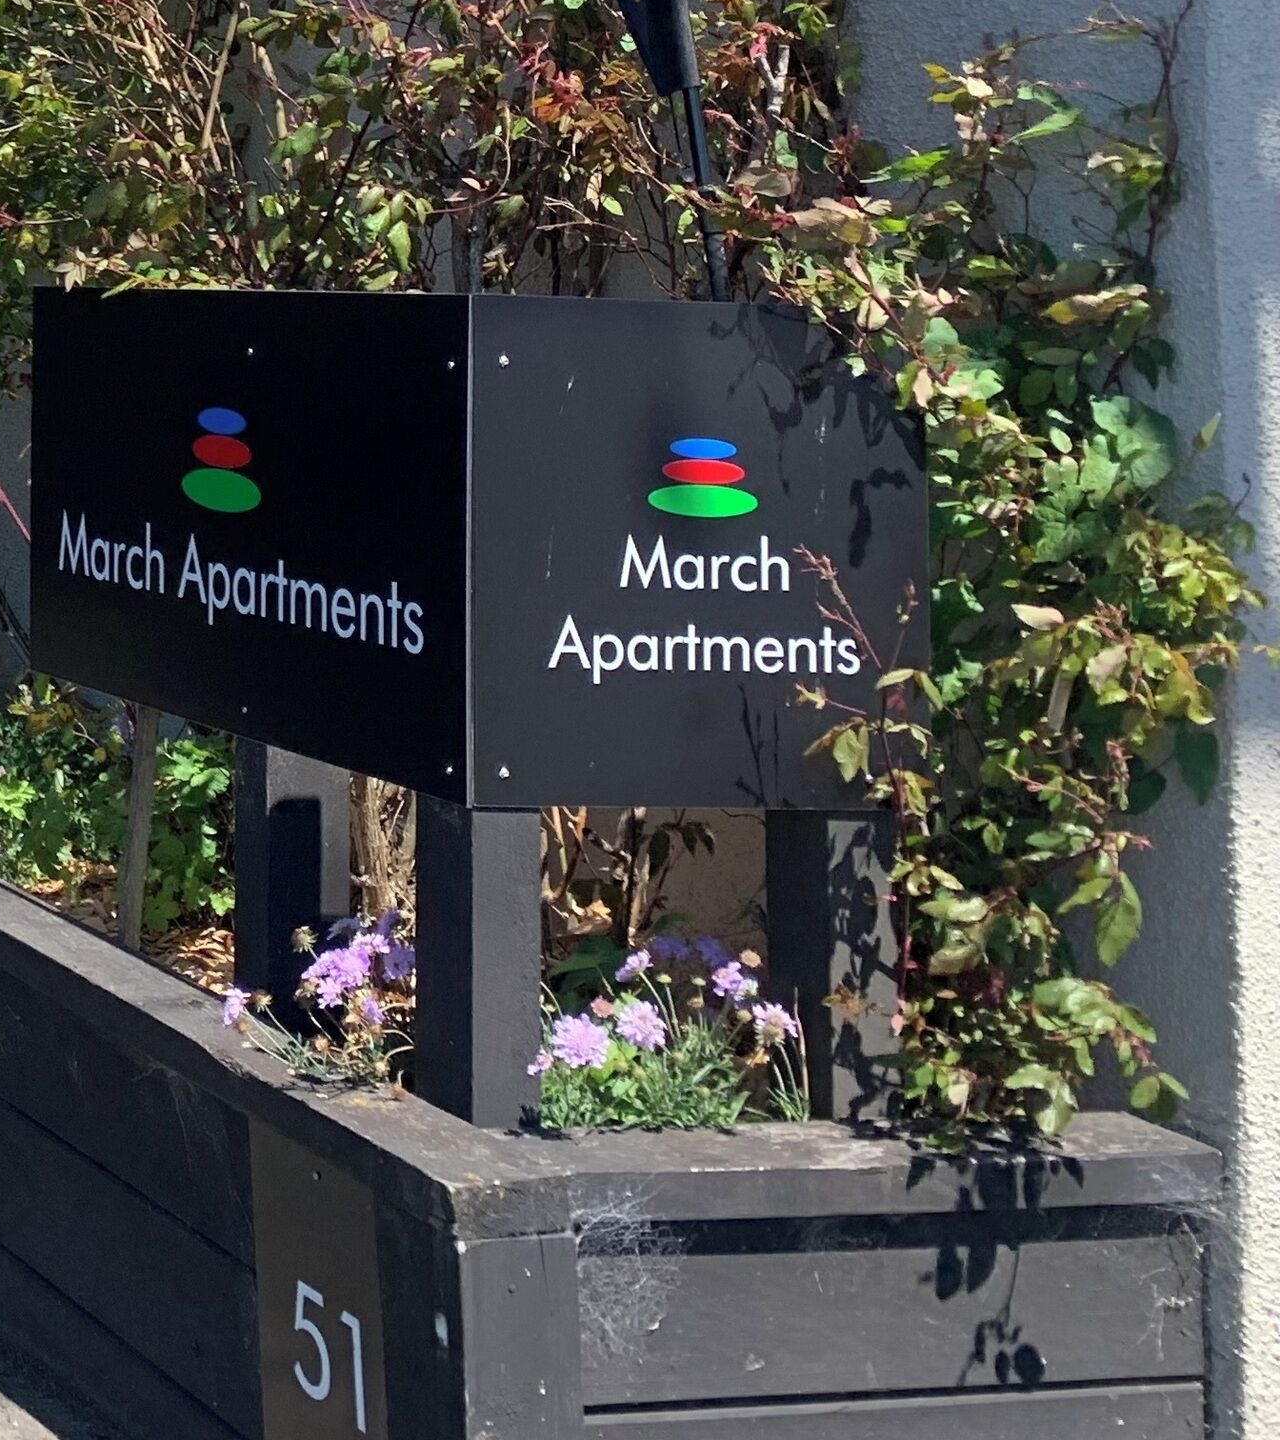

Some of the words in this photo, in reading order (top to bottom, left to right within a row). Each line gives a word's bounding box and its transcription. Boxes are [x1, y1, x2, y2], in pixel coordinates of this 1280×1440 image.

[58, 508, 166, 595] March
[177, 532, 425, 655] Apartments
[619, 532, 791, 593] March
[547, 613, 862, 686] Apartments
[293, 1279, 367, 1435] 51
